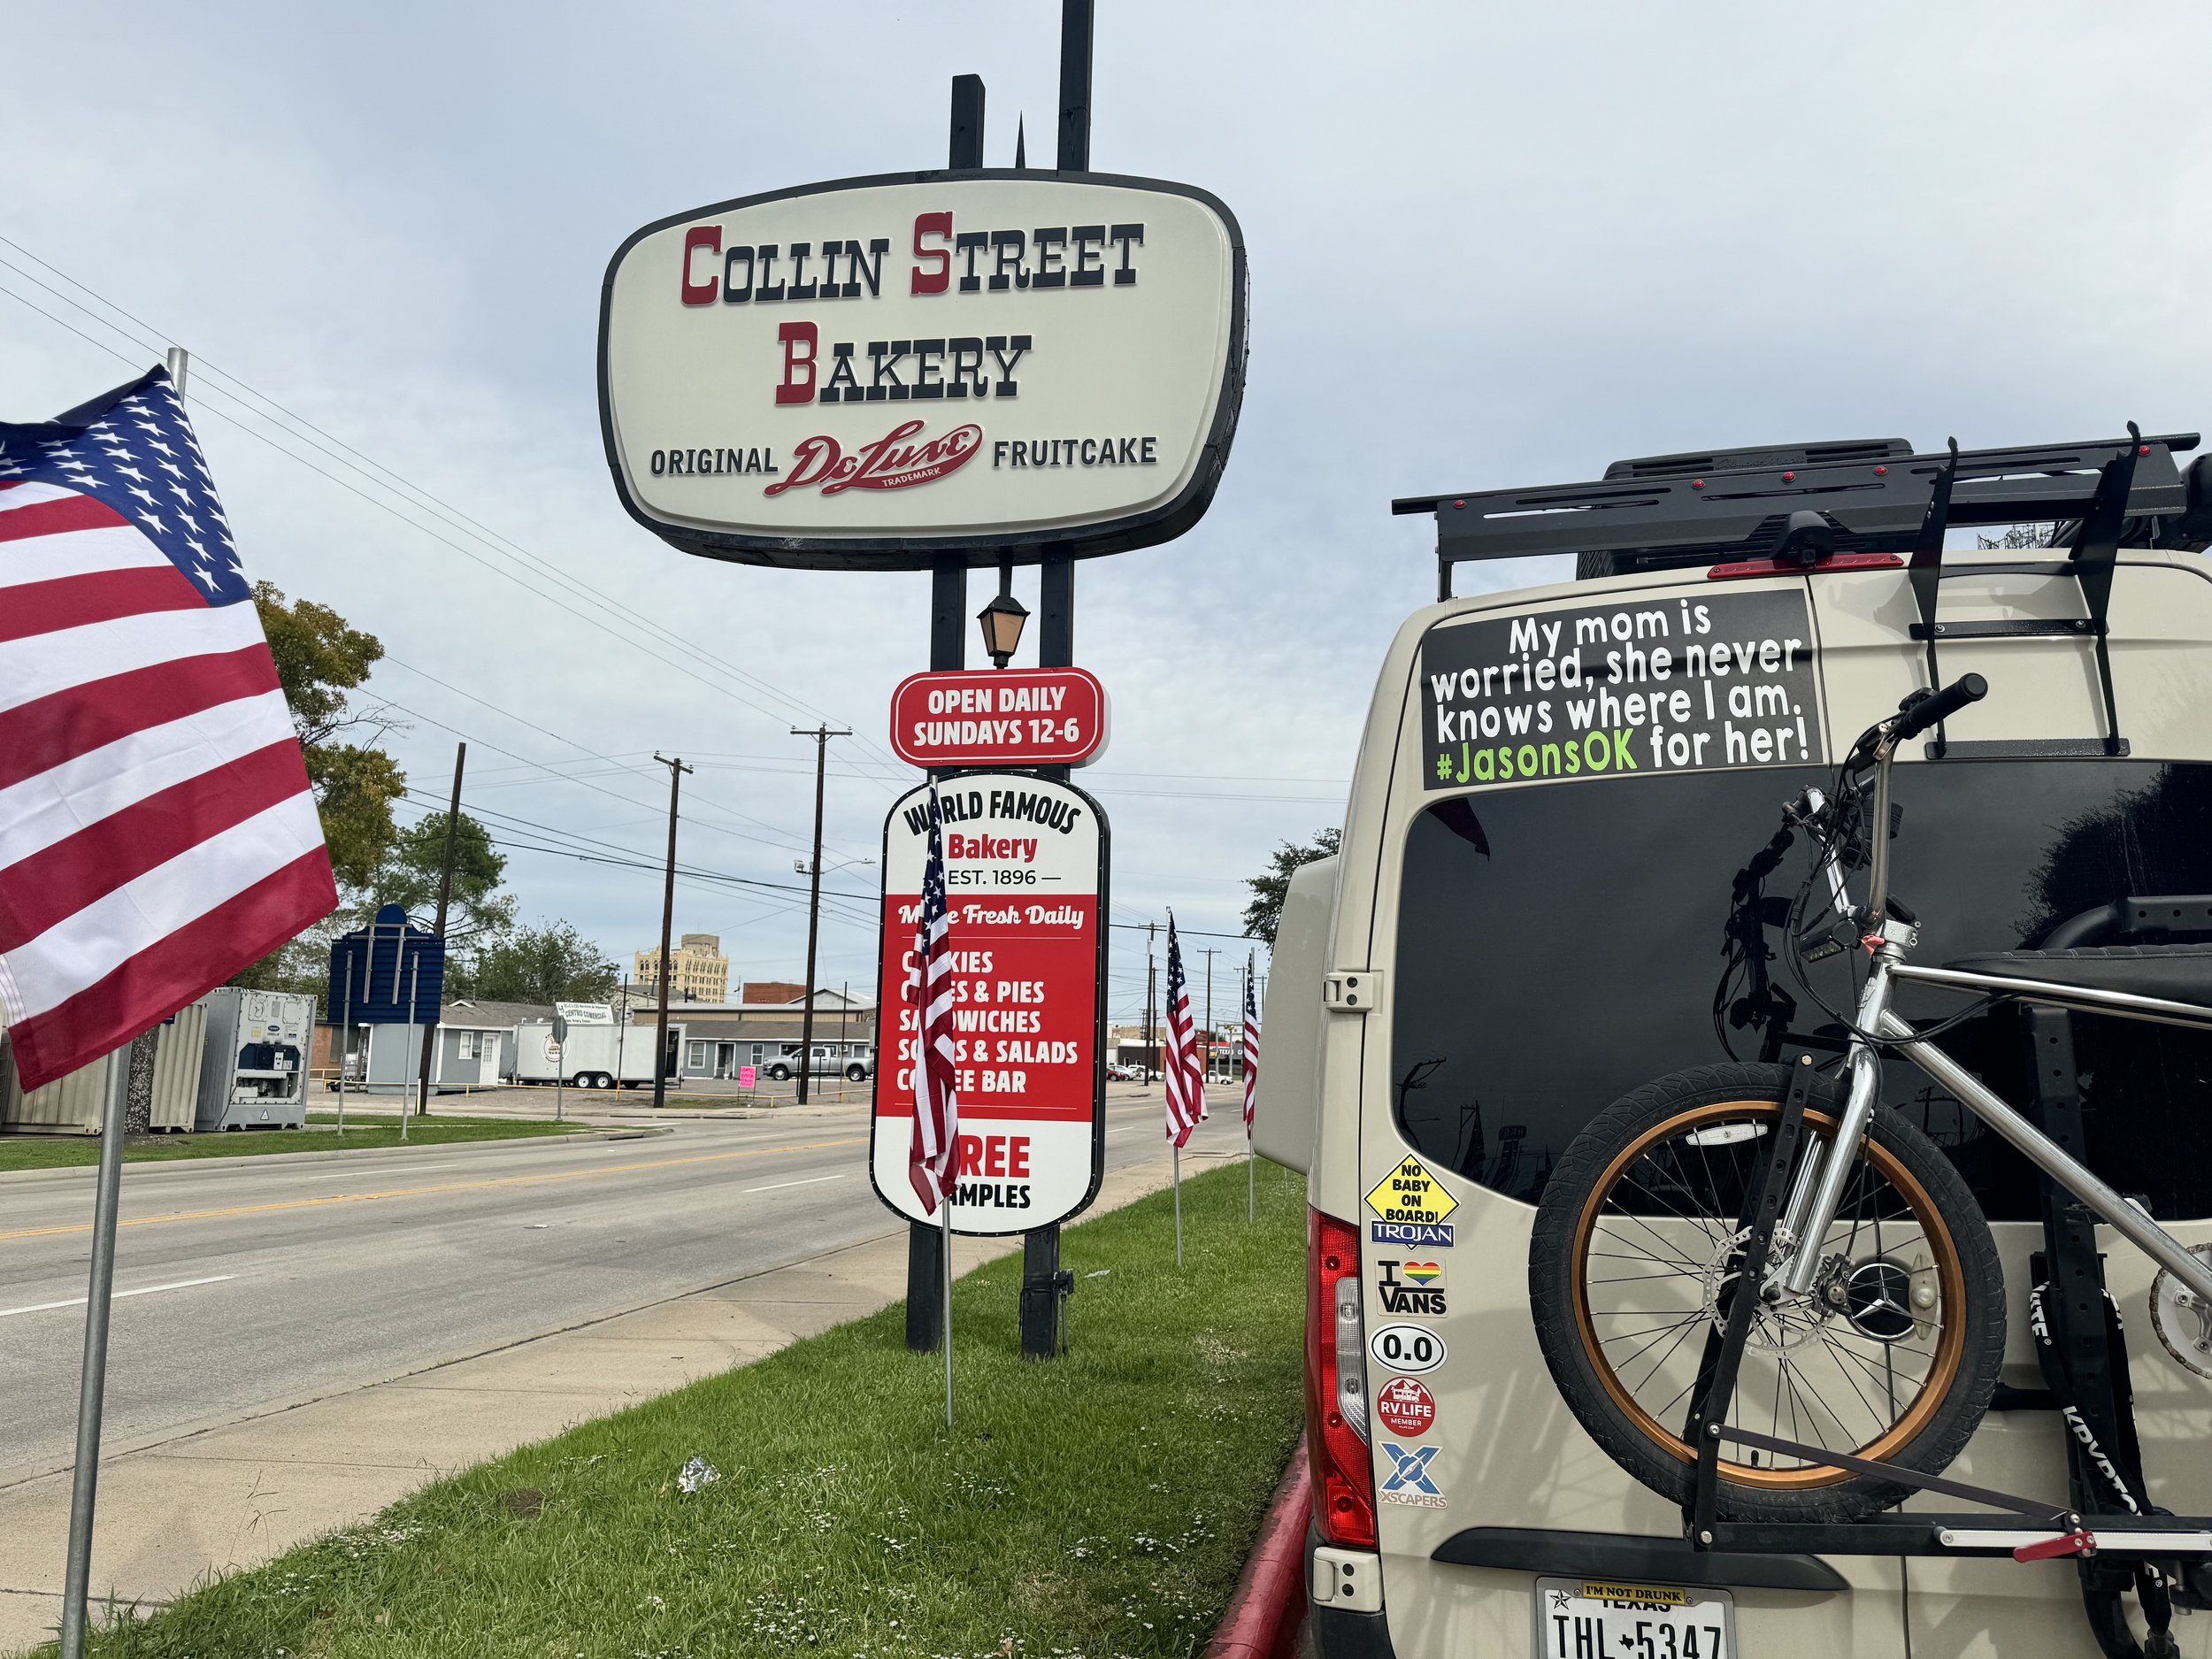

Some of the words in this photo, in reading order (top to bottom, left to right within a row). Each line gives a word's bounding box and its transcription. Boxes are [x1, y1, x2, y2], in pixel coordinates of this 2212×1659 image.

[680, 225, 889, 306] COLLIN
[910, 211, 1145, 296] STREET
[775, 321, 1033, 405] BAKERY
[650, 448, 779, 476] ORIGINAL
[764, 420, 983, 495] DeLuxe
[994, 437, 1157, 468] FRUITCAKE
[882, 467, 941, 487] TRADEMARK
[1509, 618, 1562, 657] My
[1575, 610, 1670, 647] mom
[1680, 599, 1711, 635] is
[1430, 648, 1594, 703] worried,
[1607, 641, 1672, 685] she
[1686, 638, 1802, 679] never
[929, 688, 993, 713] OPEN
[999, 687, 1066, 712] DAILY
[1437, 701, 1553, 743] knows
[1566, 687, 1692, 732] where
[1703, 680, 1716, 720] I
[1728, 683, 1801, 719] am.
[914, 719, 1022, 746] SUNDAYS
[1028, 718, 1079, 743] 12-6
[1436, 728, 1638, 784] #JasonsOK
[1650, 725, 1711, 768] for
[1724, 716, 1809, 764] her!
[903, 791, 983, 836] WRLD
[989, 790, 1082, 834] FAMOUS
[949, 833, 1038, 863] Bakery
[949, 870, 987, 885] EST.
[992, 870, 1036, 885] 1896
[898, 905, 959, 924] Me
[963, 904, 1021, 925] Fresh
[1025, 905, 1084, 930] Daily
[902, 950, 994, 973] CKIES
[973, 980, 990, 1002] &
[997, 981, 1045, 1003] PIES
[973, 1040, 989, 1063] &
[995, 1041, 1079, 1064] SALADS
[981, 1070, 1026, 1094] BAR
[958, 1134, 1031, 1178] REE
[1402, 1164, 1421, 1177] NO
[1393, 1179, 1431, 1192] BABY
[1402, 1194, 1421, 1207] ON
[1386, 1209, 1439, 1223] BOARD!
[1373, 1223, 1452, 1243] TROJAN
[1378, 1260, 1401, 1286] I
[1378, 1286, 1447, 1314] VANS
[1383, 1334, 1432, 1362] 0.0
[1380, 1401, 1400, 1414] RV
[1402, 1403, 1432, 1417] LIFE
[1391, 1417, 1422, 1426] MEMBER
[1379, 1491, 1447, 1508] XSCAPERS
[1586, 1586, 1605, 1595] I'M
[1607, 1587, 1632, 1598] NOT
[1636, 1590, 1682, 1601] DRUNK
